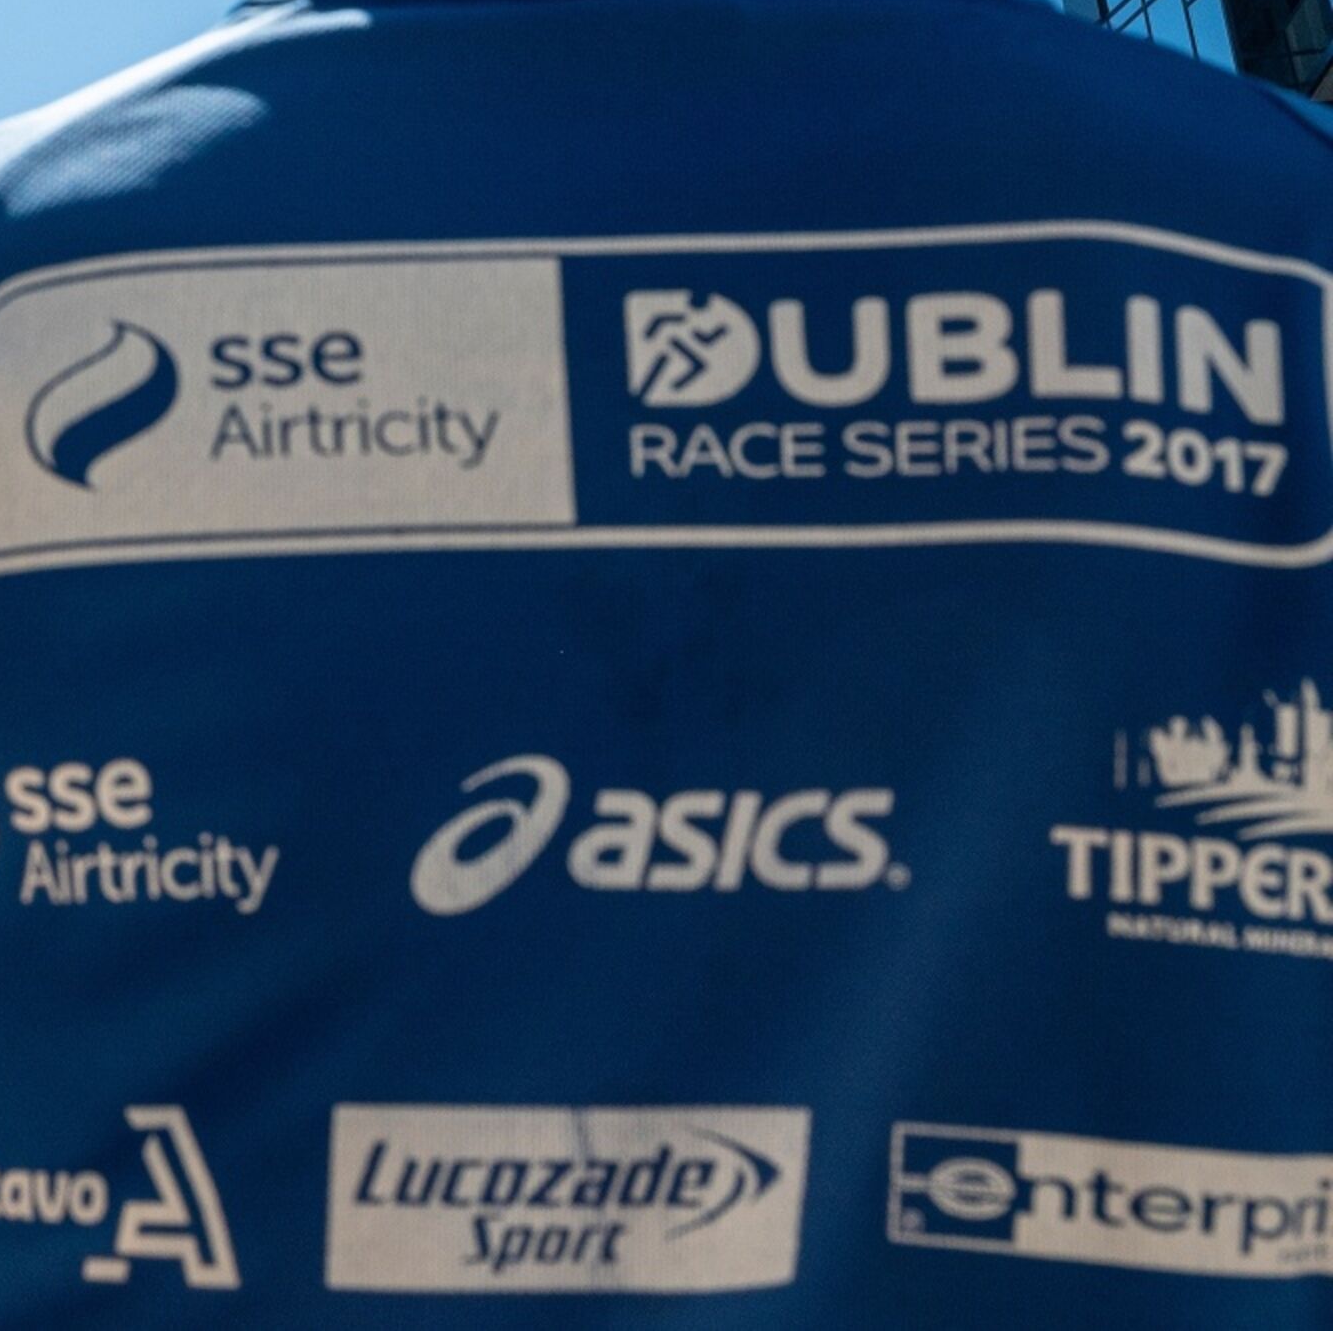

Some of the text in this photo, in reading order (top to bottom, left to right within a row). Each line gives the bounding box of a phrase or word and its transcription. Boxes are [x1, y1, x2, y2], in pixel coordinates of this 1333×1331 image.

[209, 330, 363, 391] sse
[623, 288, 1285, 426] DUBLIN
[209, 396, 501, 470] Airtricity
[630, 415, 1287, 497] RACE SERIES 2017
[4, 757, 154, 834] sse
[19, 831, 280, 915] Airtricity
[353, 1139, 717, 1210] Lucozade
[464, 1212, 629, 1276] Sport
